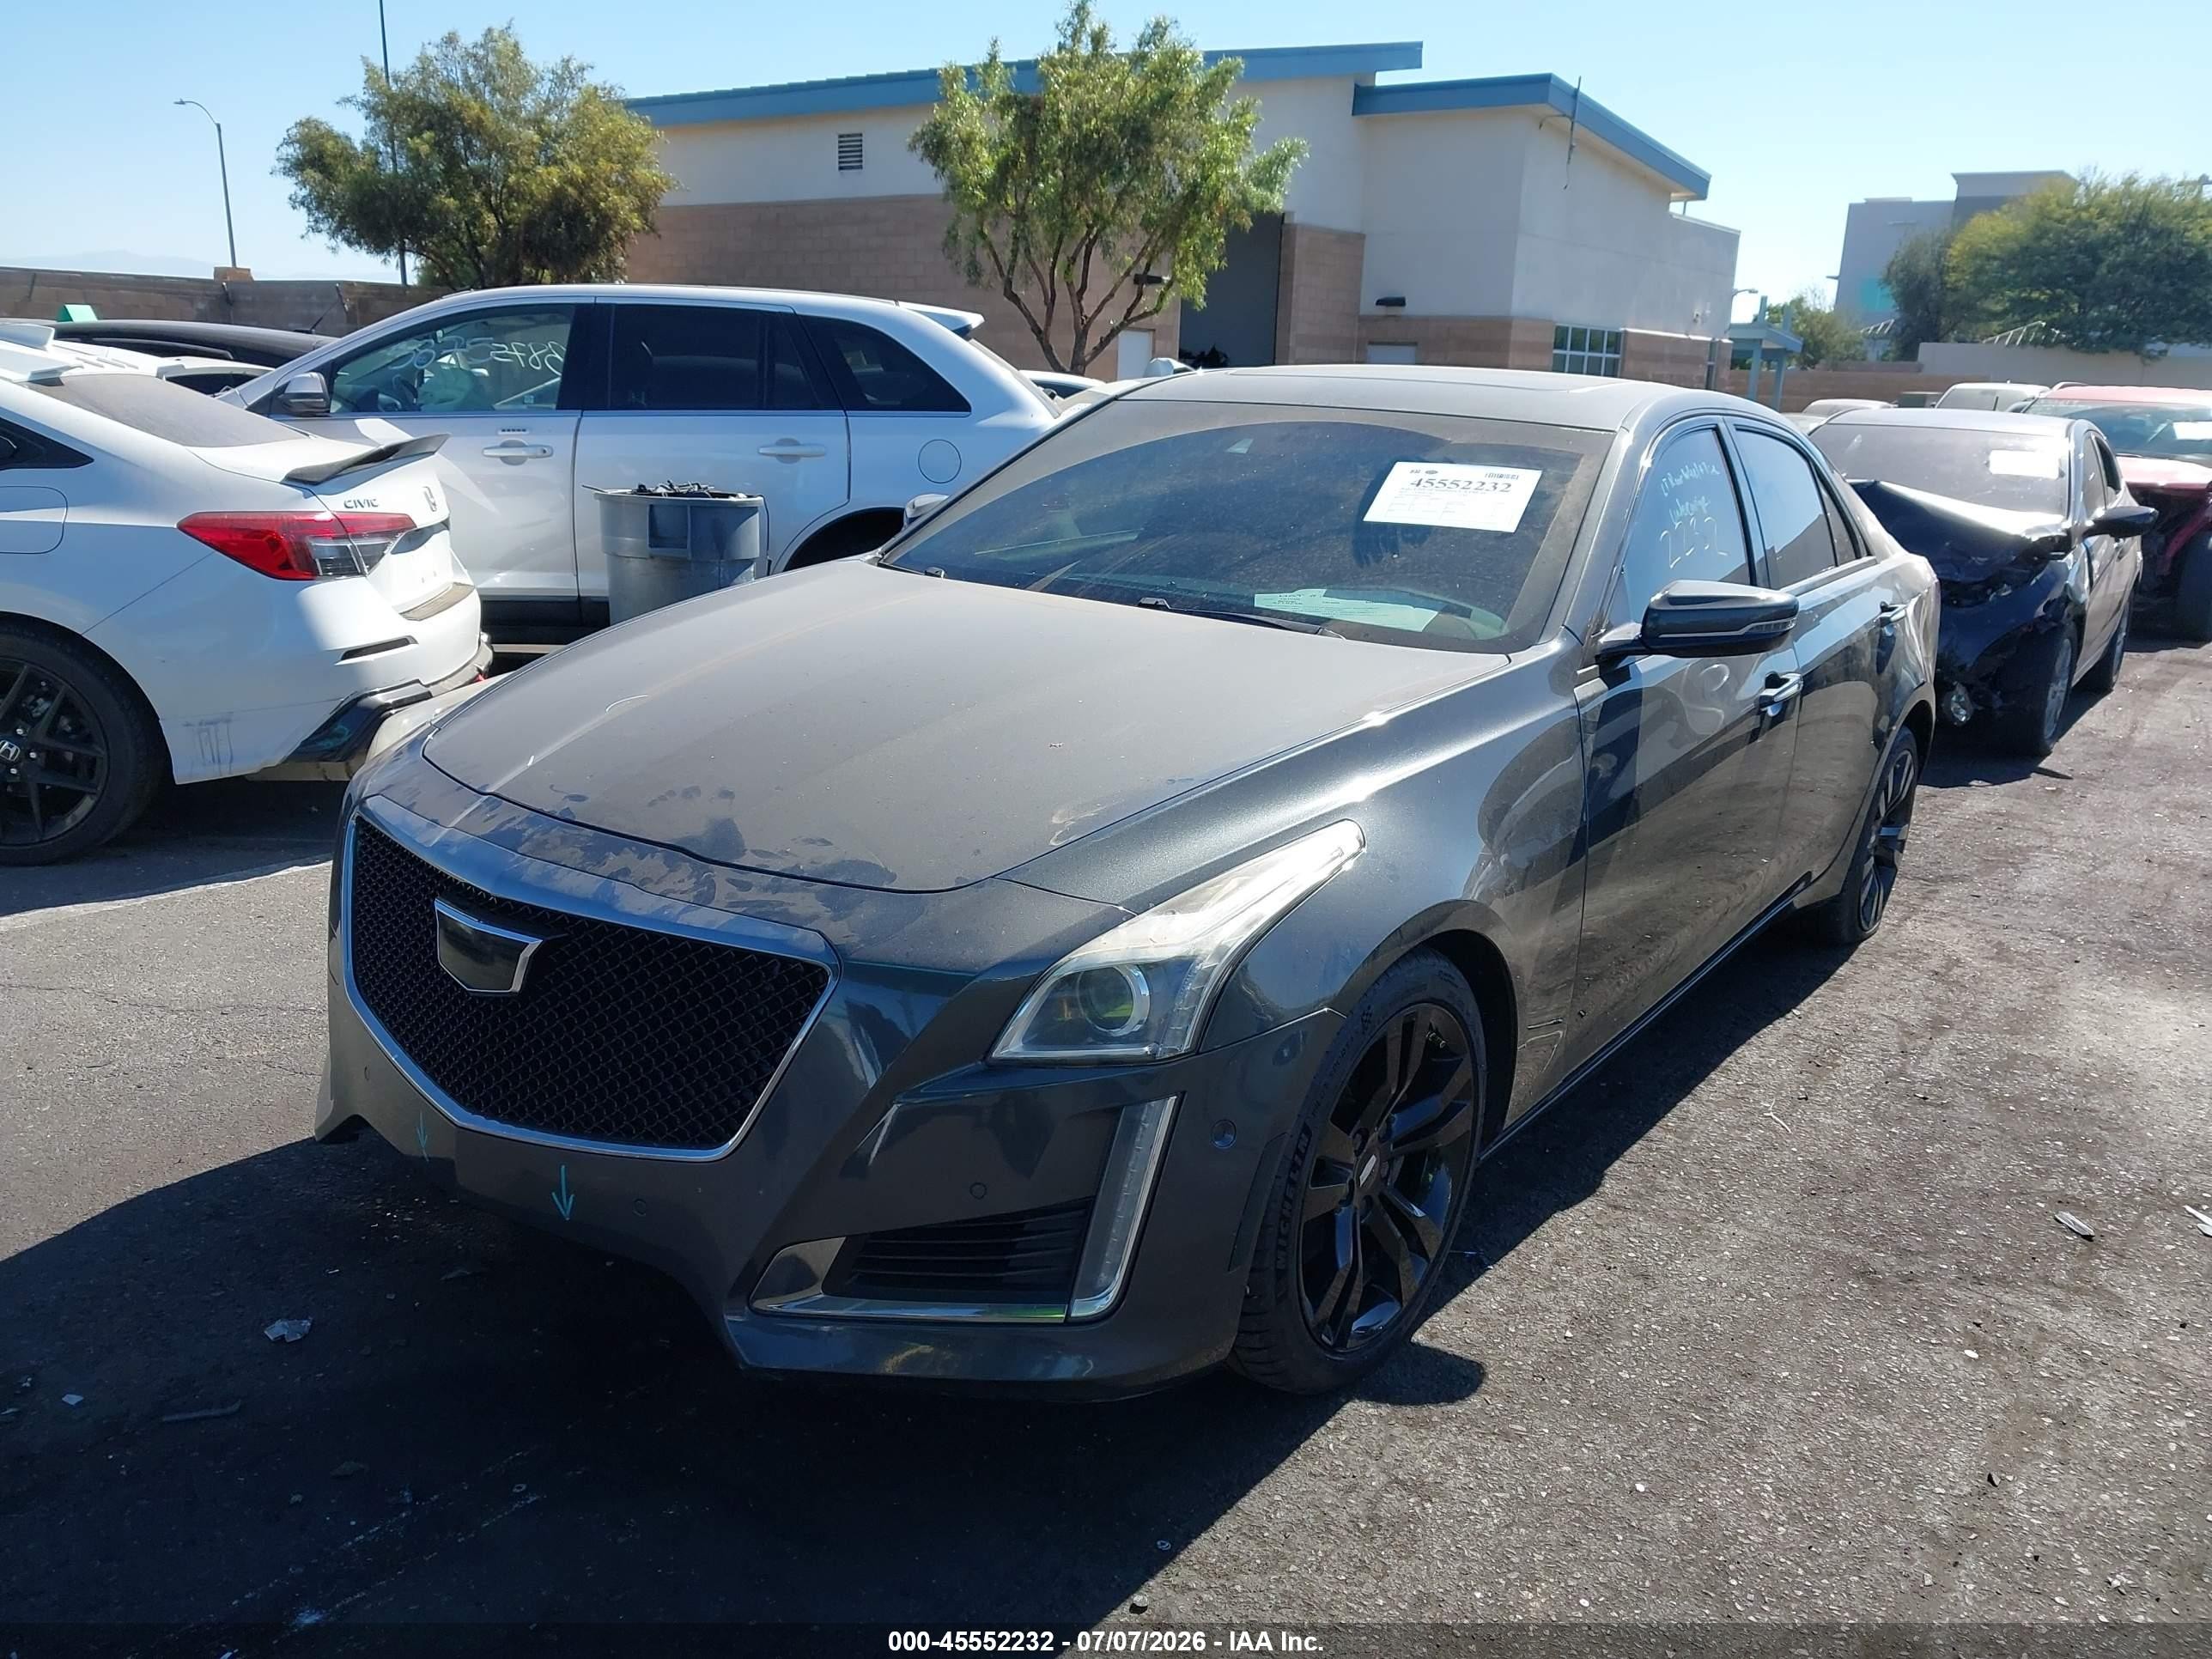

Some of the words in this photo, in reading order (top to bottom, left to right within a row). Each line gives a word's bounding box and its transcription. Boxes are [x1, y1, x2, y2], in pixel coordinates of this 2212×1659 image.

[1410, 477, 1512, 493] 45552232
[343, 498, 380, 508] CIVIC
[1277, 1132, 1311, 1271] MICHELIN
